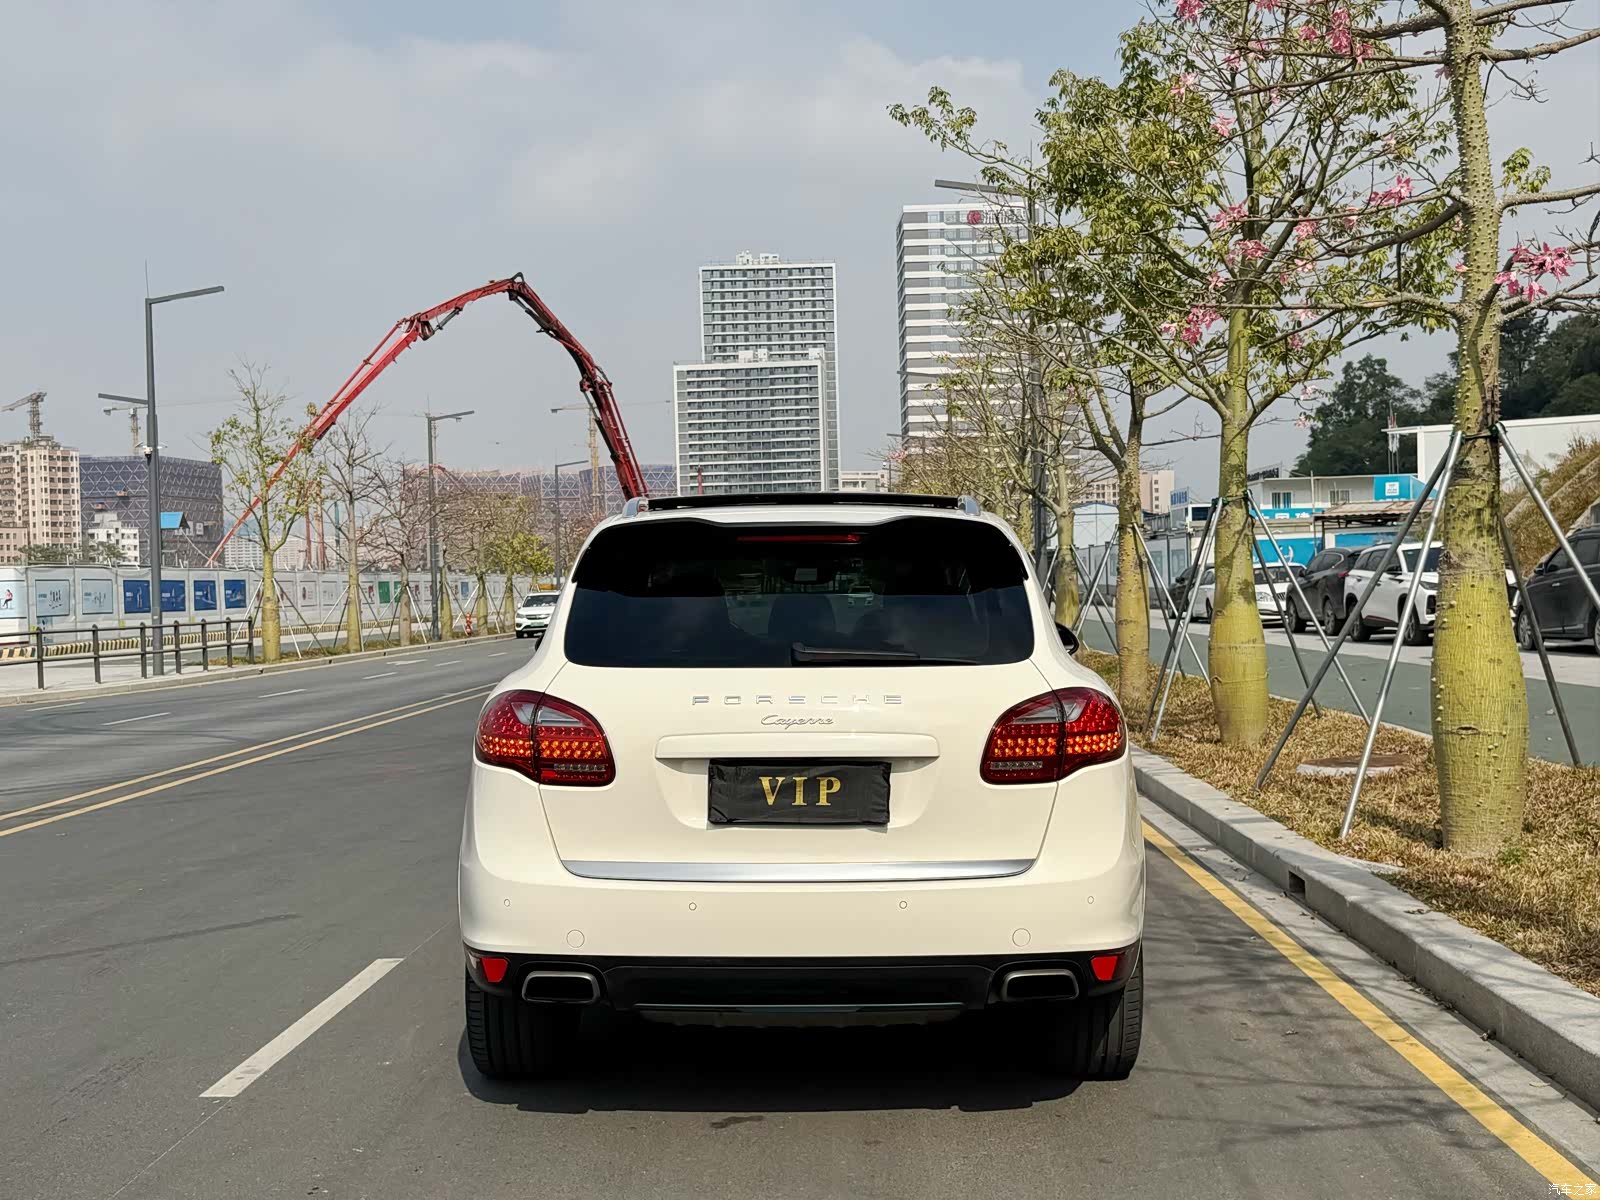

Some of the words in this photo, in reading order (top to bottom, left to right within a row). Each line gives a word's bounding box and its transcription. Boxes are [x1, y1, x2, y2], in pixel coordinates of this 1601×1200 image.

[692, 695, 902, 705] PORSCHE
[760, 714, 834, 730] Cayenne
[759, 776, 842, 806] VIP
